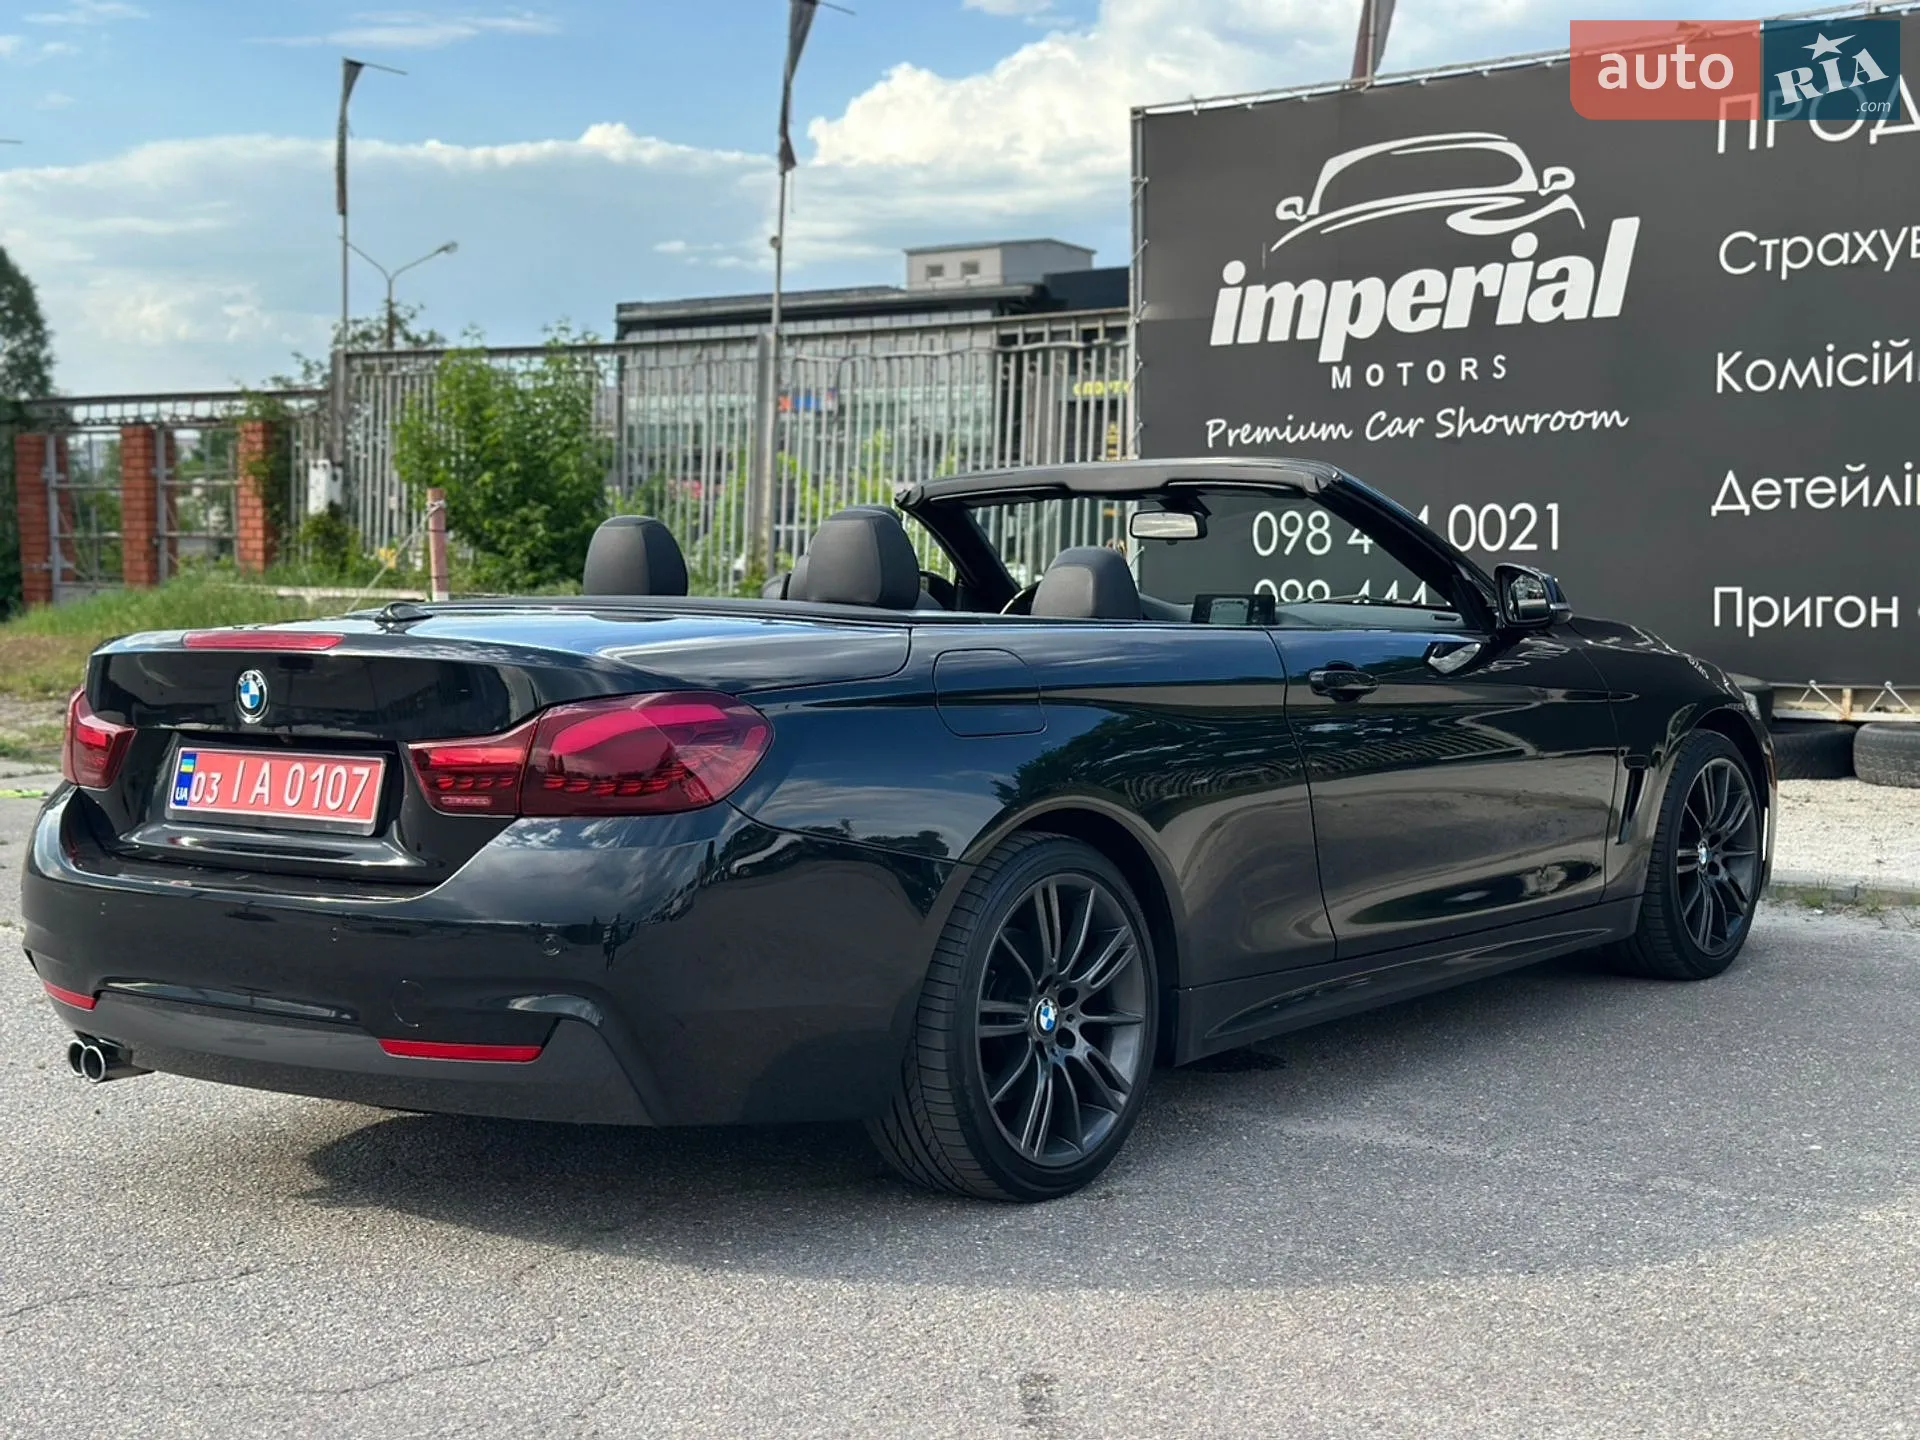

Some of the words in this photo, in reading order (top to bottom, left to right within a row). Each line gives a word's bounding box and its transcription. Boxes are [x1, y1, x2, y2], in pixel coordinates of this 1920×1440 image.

[1209, 216, 1641, 363] imperial
[1331, 354, 1508, 389] MOTORS
[1716, 338, 1920, 394] Комісій
[1205, 414, 1353, 449] Premium
[1365, 410, 1425, 442] Car
[1435, 406, 1630, 439] Showroom
[1710, 461, 1920, 517] Детейлі
[1252, 510, 1332, 557] 098
[1447, 502, 1559, 552] 0021
[1714, 586, 1899, 638] Пригон
[174, 787, 188, 801] UA
[190, 772, 222, 804] 03
[284, 763, 371, 813] 0107
